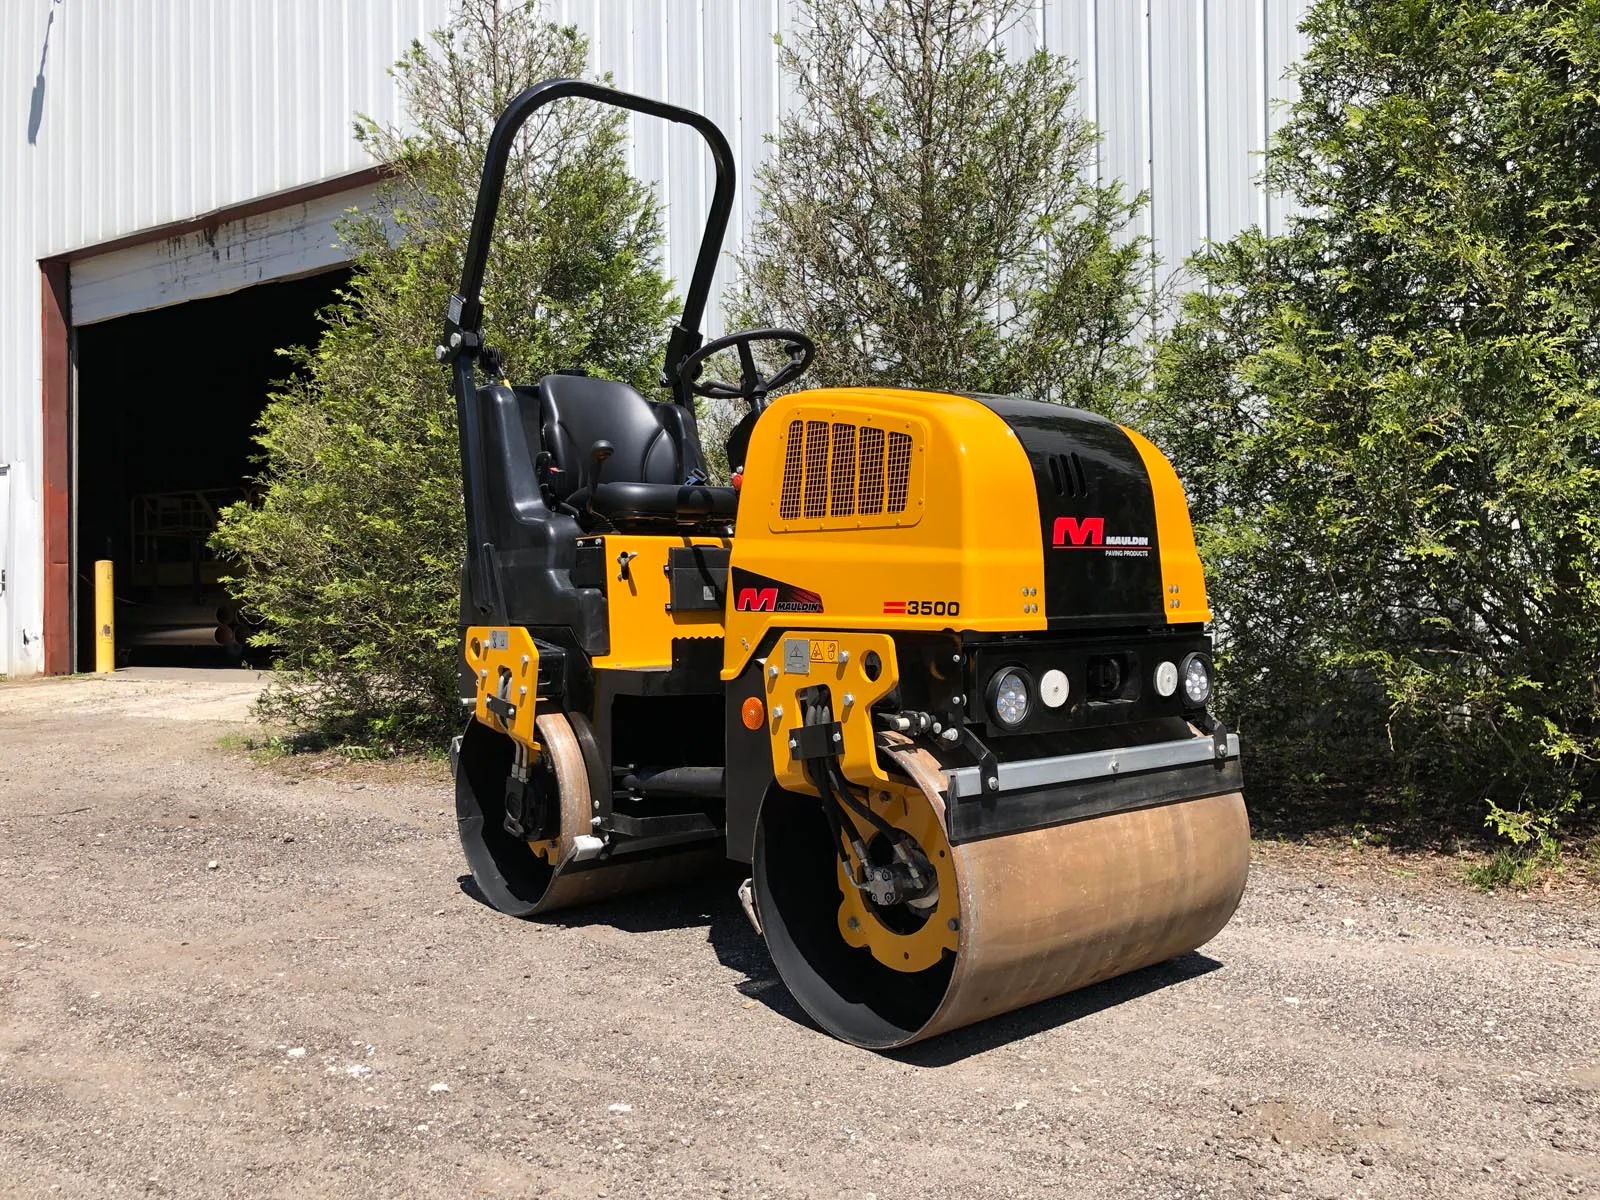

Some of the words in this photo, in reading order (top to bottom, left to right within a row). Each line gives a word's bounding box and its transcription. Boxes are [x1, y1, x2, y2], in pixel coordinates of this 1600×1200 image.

[1053, 517, 1104, 544] M
[1105, 536, 1149, 545] MAULDIN
[737, 588, 778, 612] M
[777, 602, 819, 612] MAULDIN
[907, 601, 960, 616] 3500
